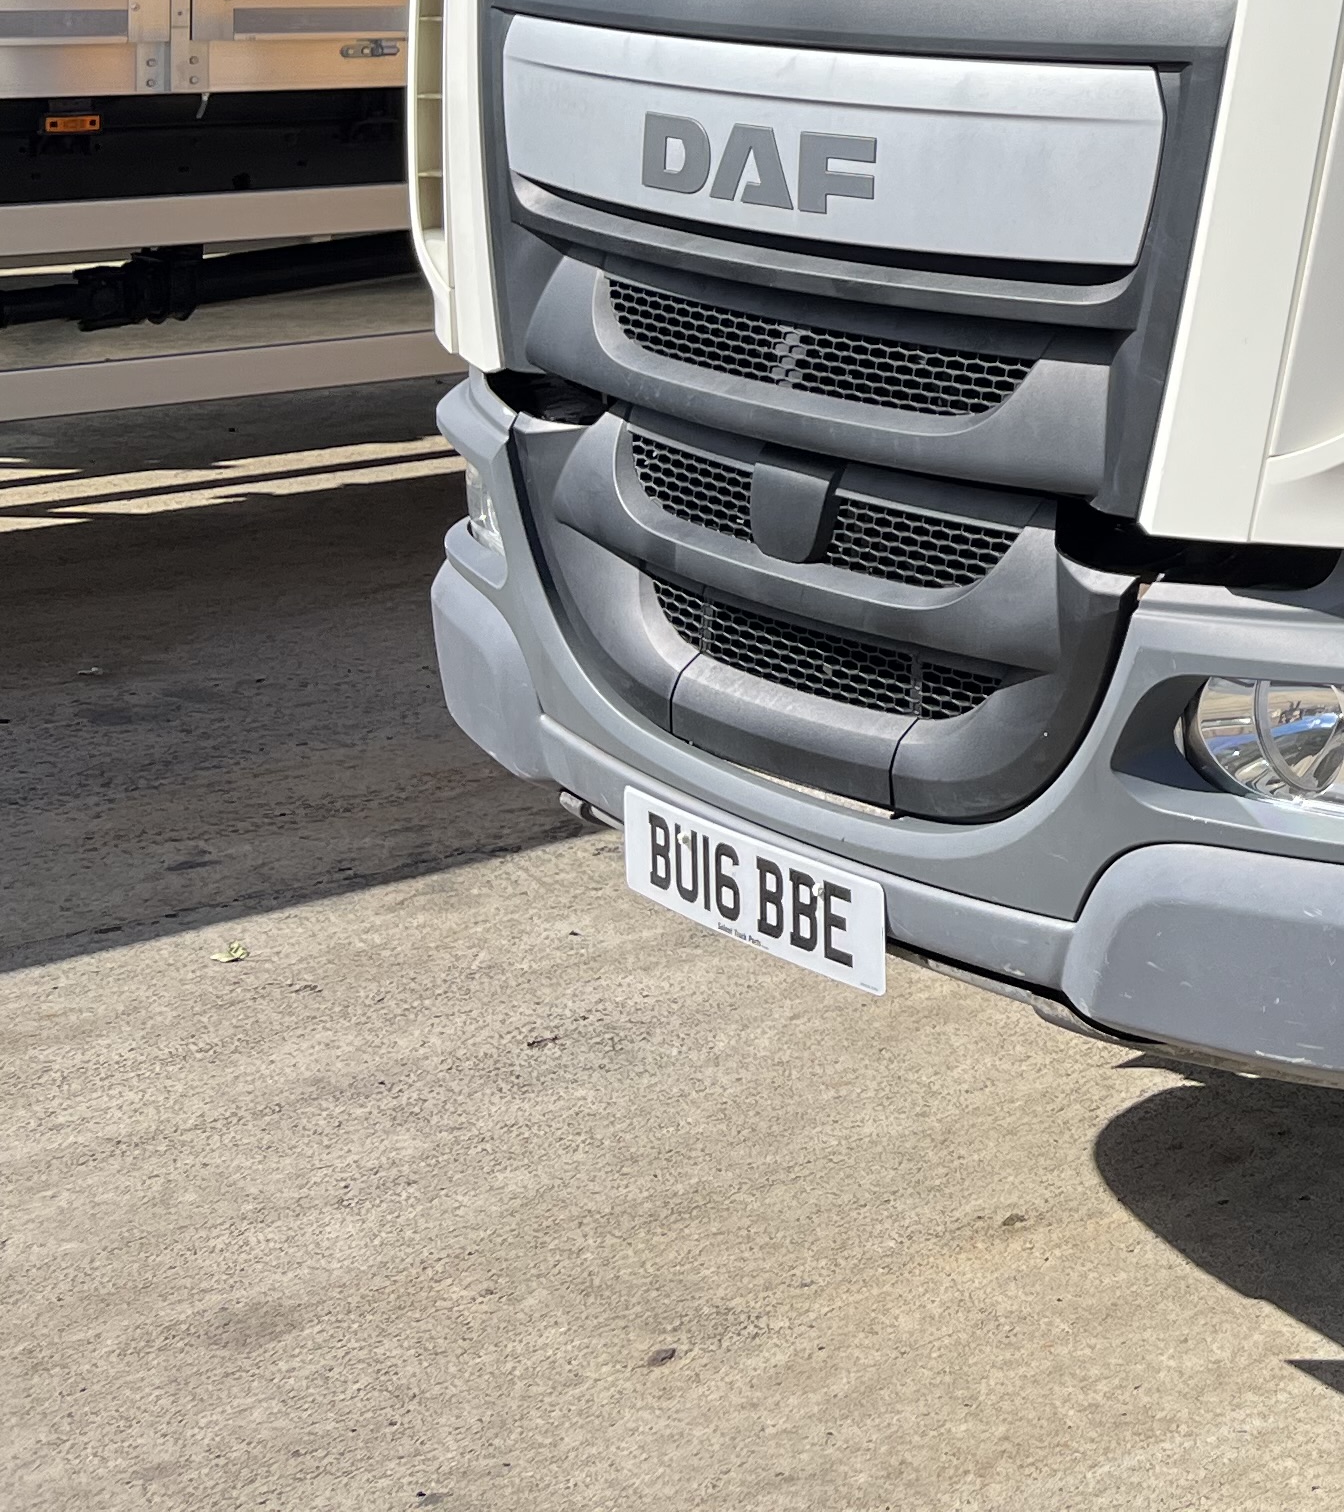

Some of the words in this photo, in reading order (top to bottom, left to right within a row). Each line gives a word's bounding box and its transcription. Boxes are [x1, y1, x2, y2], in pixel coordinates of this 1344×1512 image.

[642, 110, 878, 215] DAF
[648, 811, 740, 921] BU16
[756, 855, 853, 968] BBE
